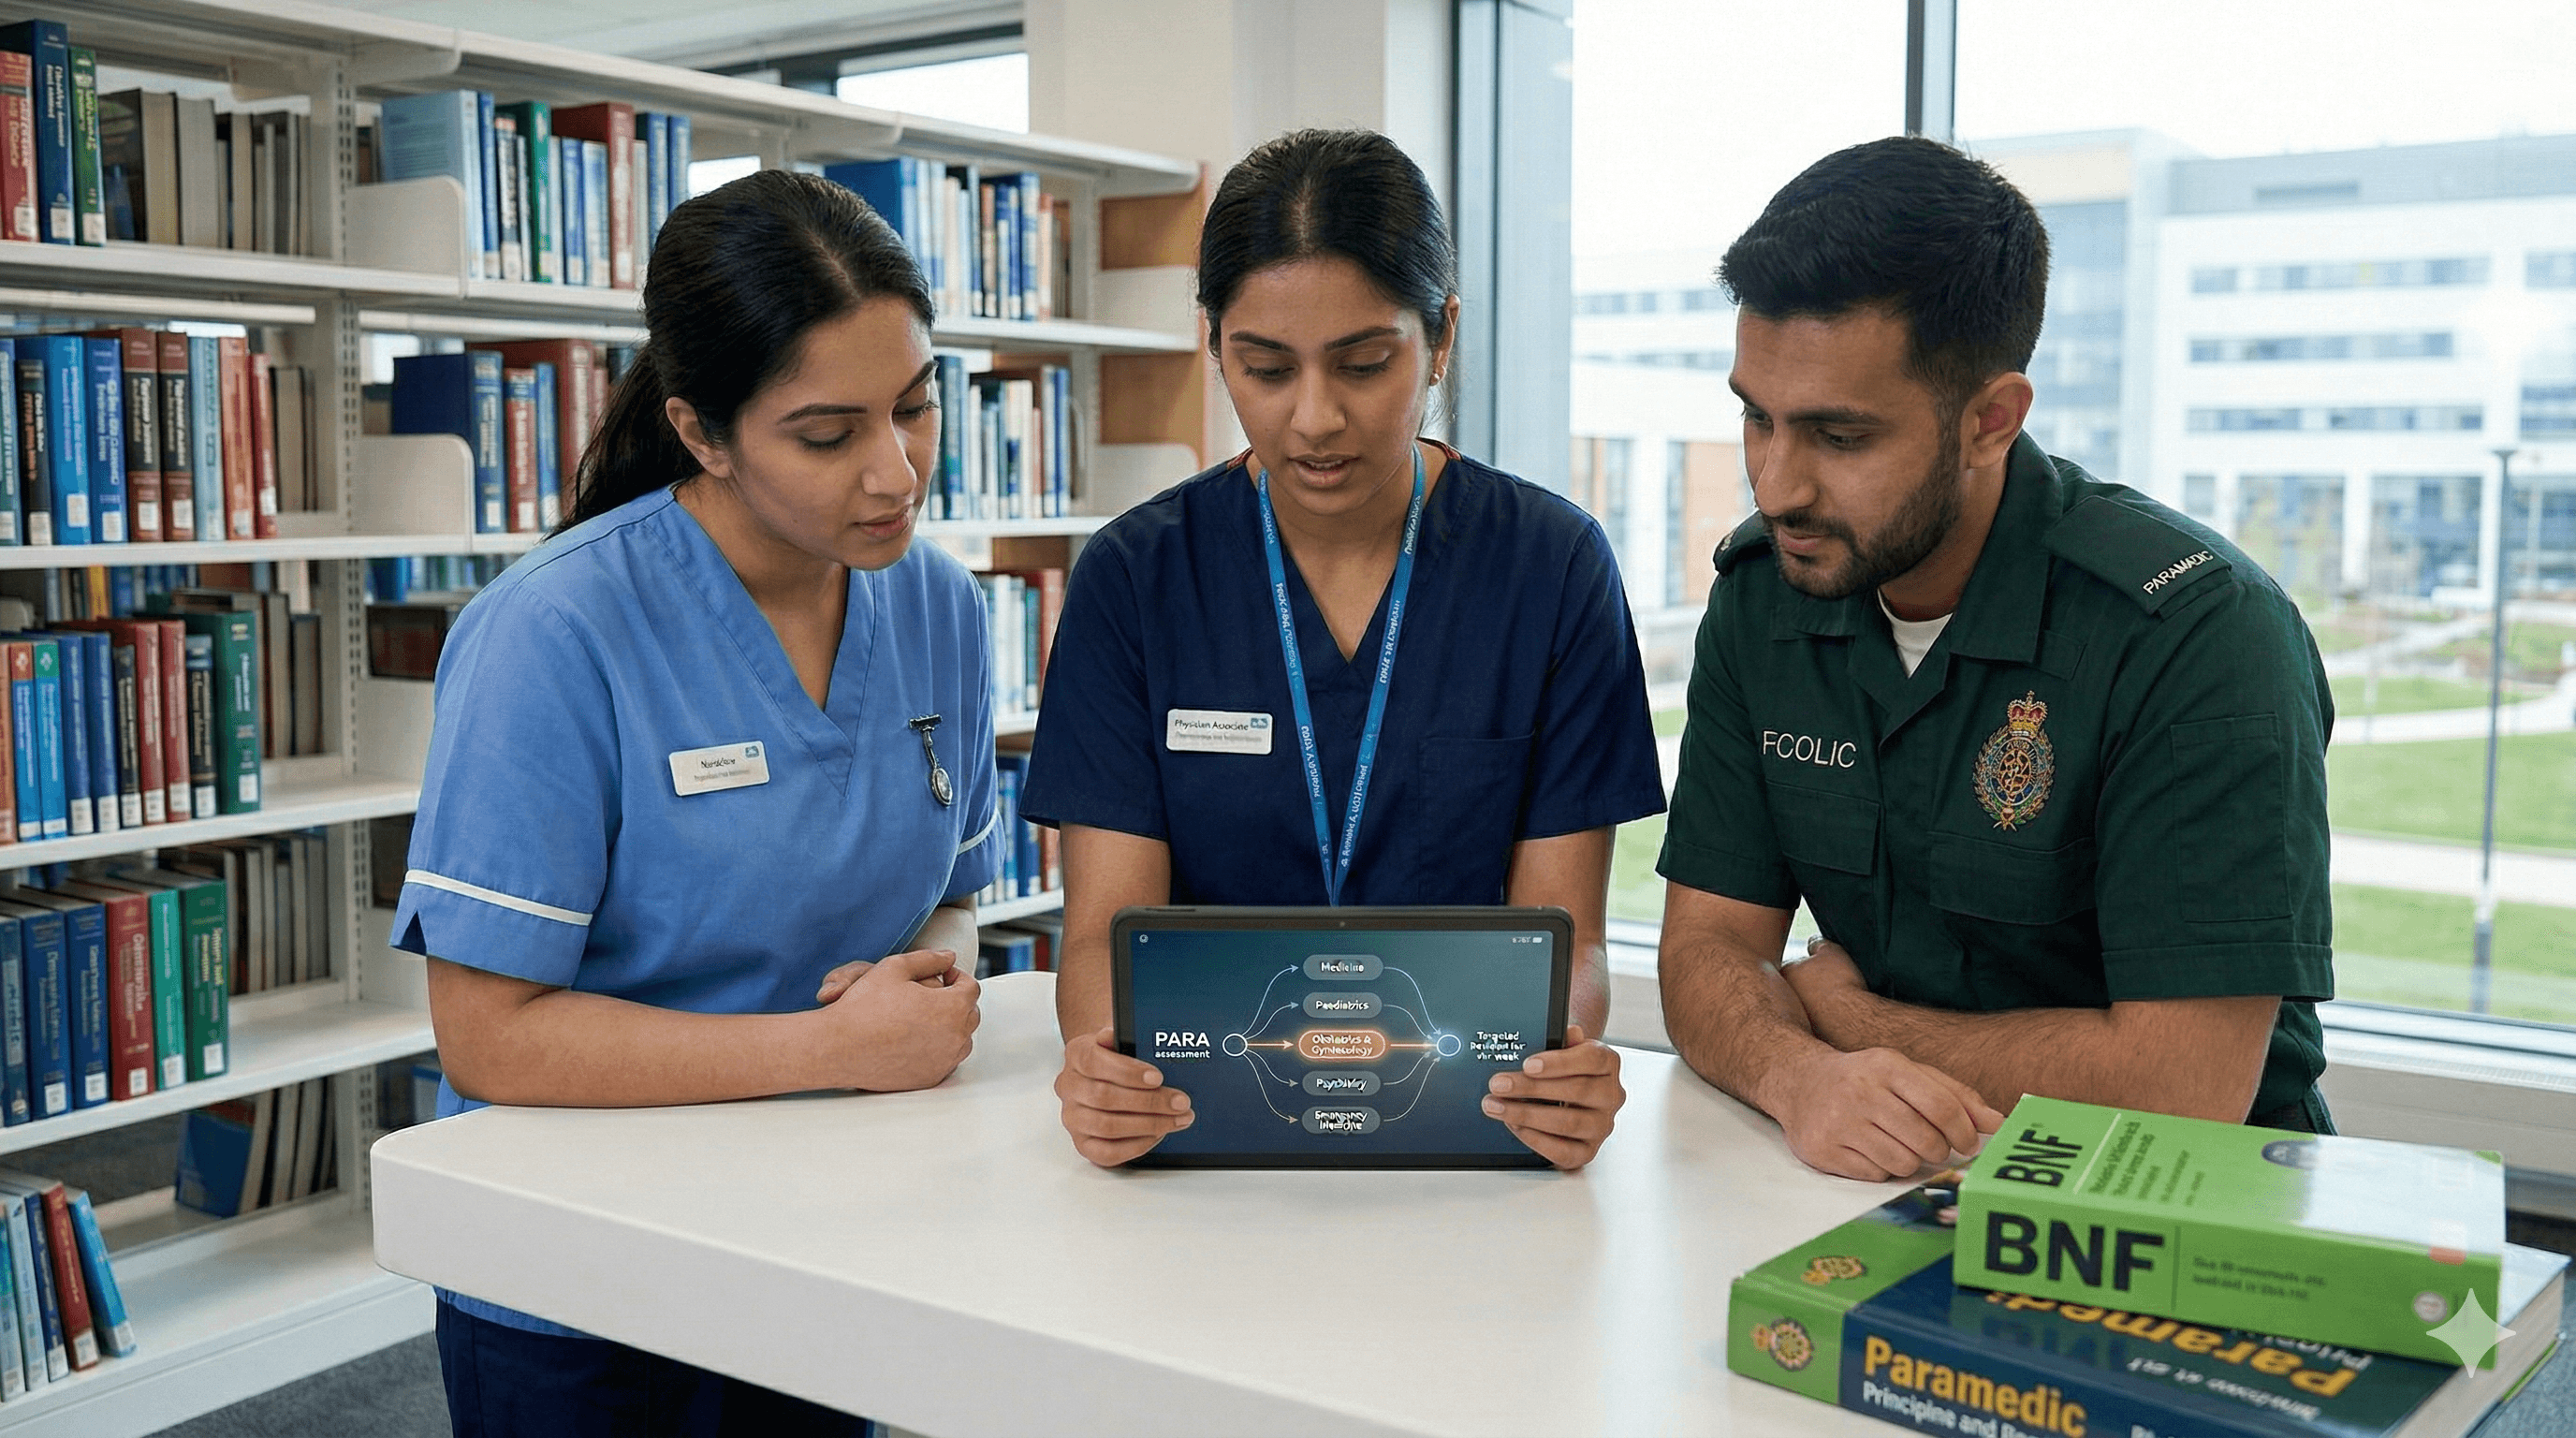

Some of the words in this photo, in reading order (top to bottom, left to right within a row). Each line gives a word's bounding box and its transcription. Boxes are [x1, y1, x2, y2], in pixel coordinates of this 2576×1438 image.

[1763, 730, 1856, 768] FCOLIC
[1155, 1032, 1210, 1047] PARA
[1993, 1128, 2084, 1187] BNF
[1985, 1211, 2165, 1292] BNF
[1865, 1334, 2087, 1438] Paramedic
